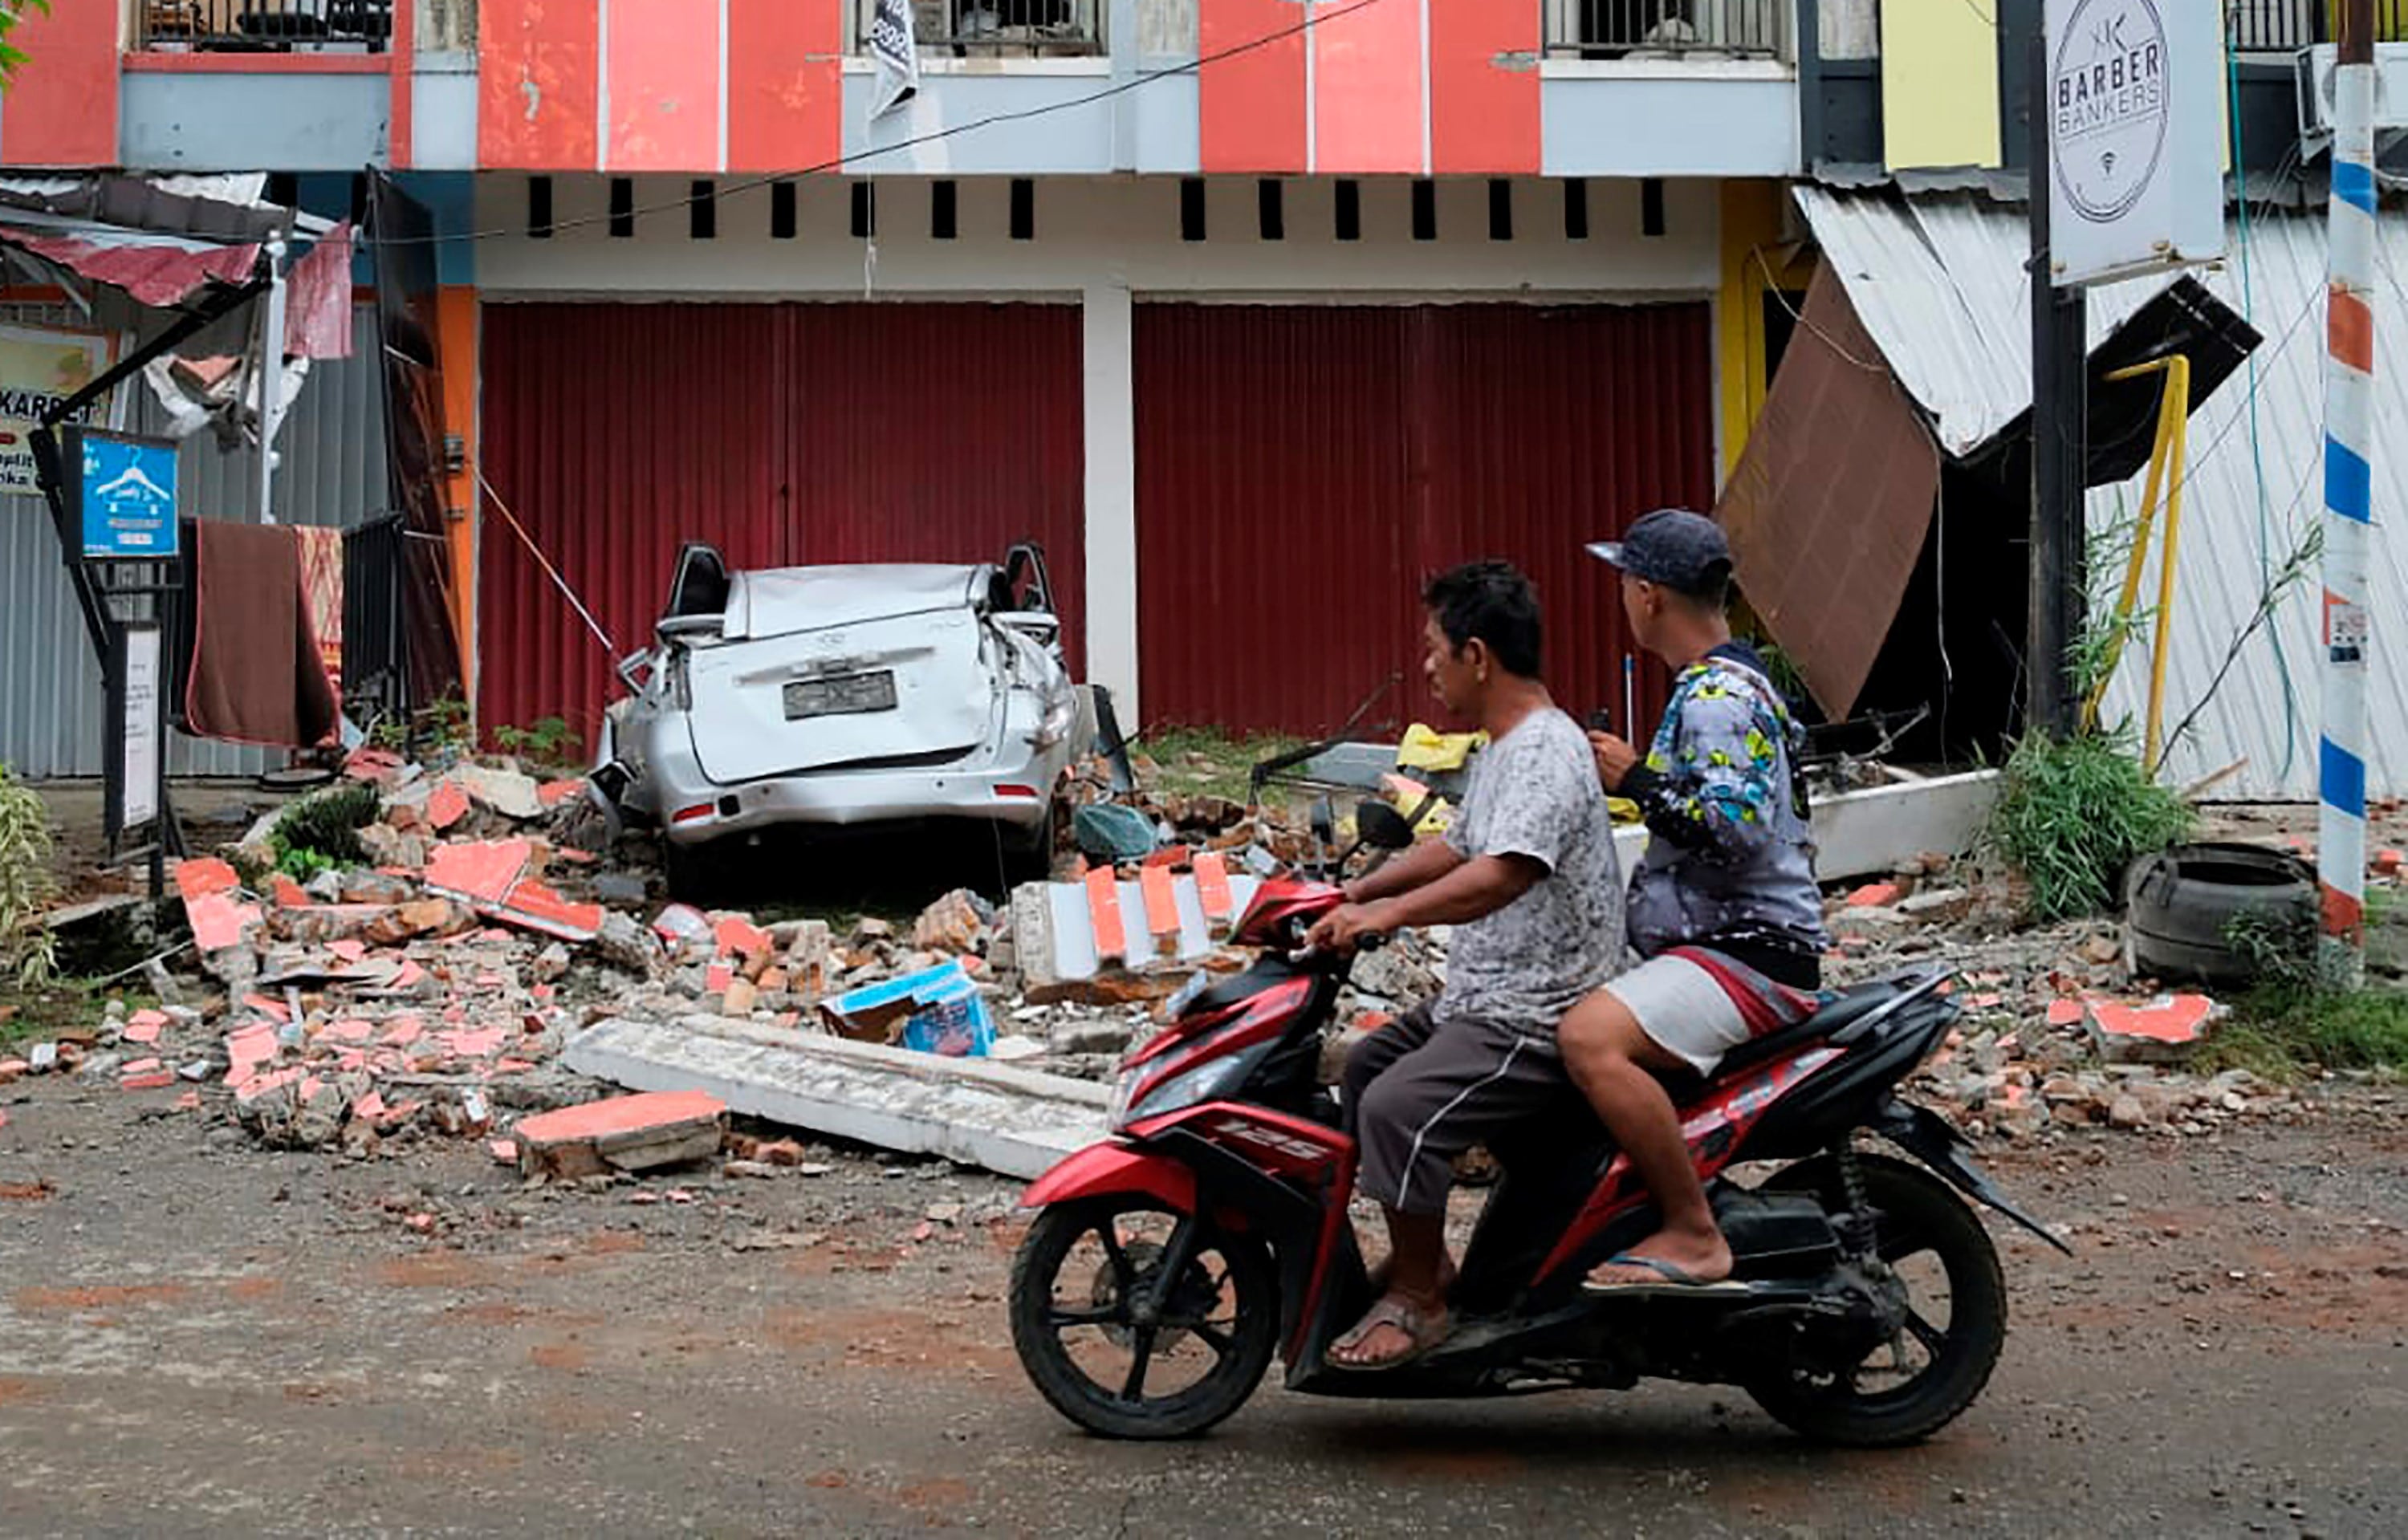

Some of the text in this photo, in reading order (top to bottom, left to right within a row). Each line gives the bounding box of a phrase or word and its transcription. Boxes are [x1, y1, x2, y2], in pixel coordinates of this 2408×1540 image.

[2058, 43, 2159, 108] BARBER
[2058, 79, 2160, 133] BANKERS
[1213, 1119, 1333, 1160] 125
